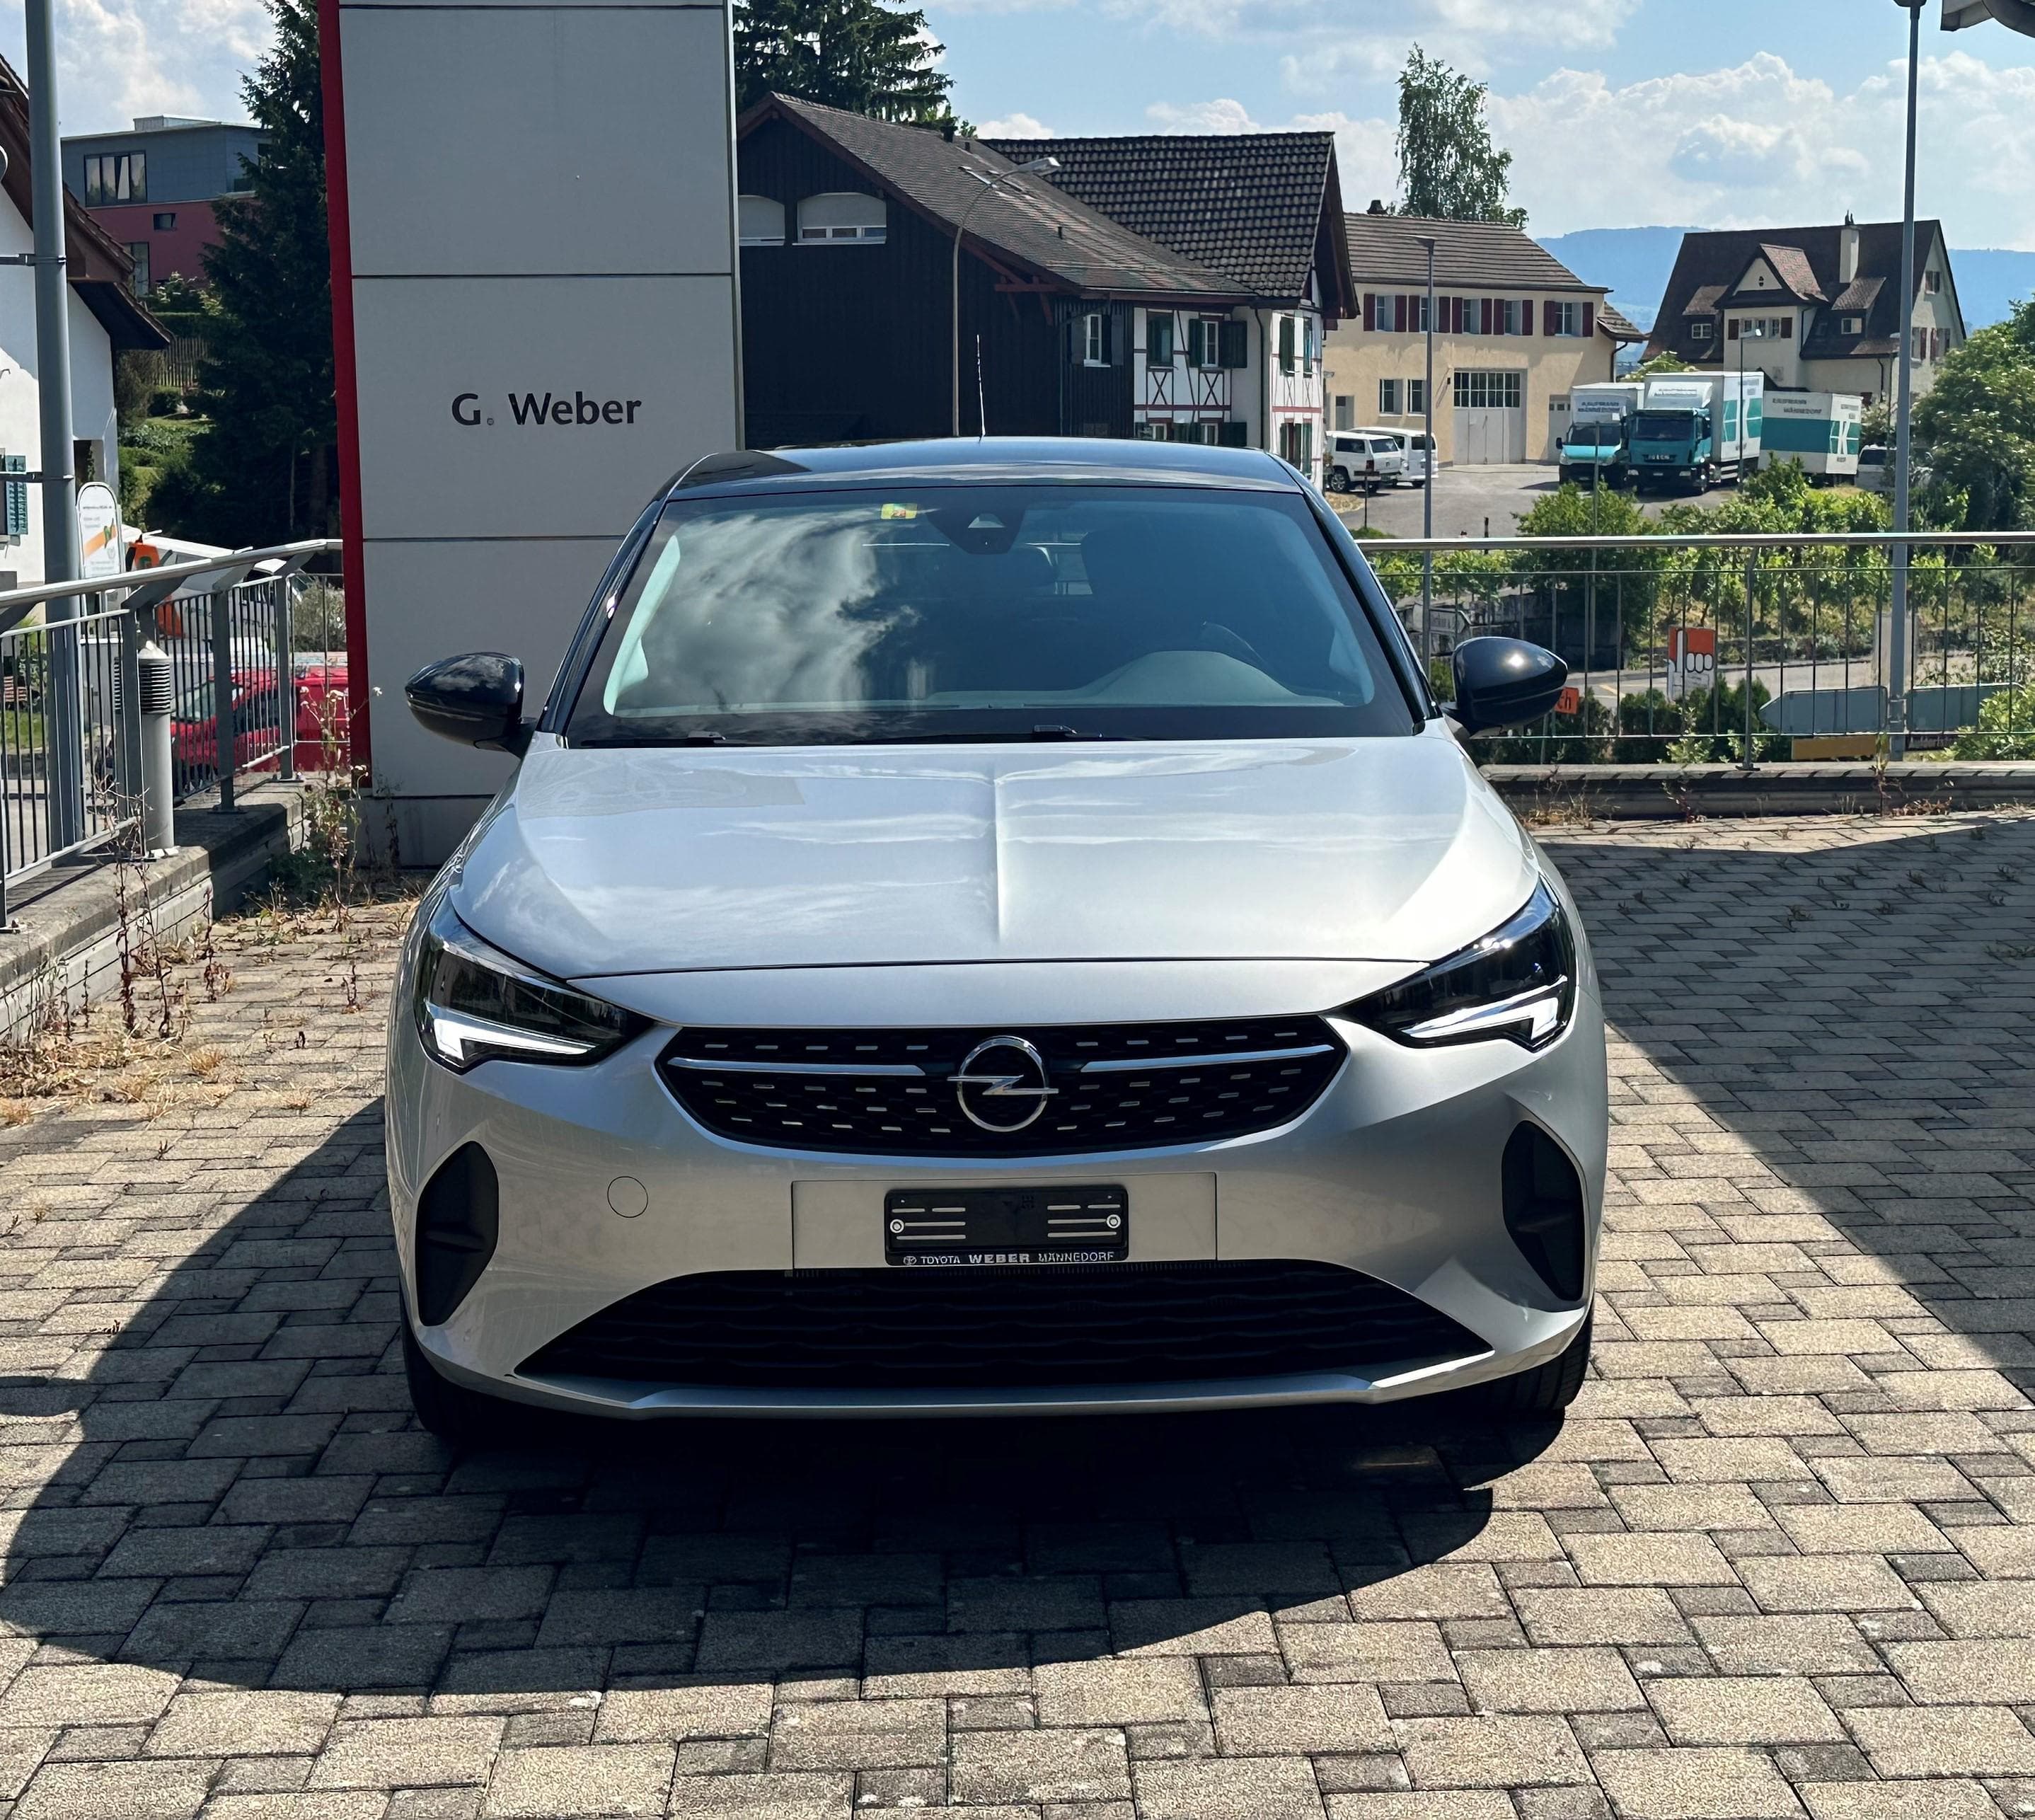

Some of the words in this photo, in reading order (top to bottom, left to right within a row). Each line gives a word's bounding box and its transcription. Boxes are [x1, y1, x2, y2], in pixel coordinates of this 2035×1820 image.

[451, 393, 495, 425] G.
[507, 391, 642, 425] Weber
[921, 1255, 960, 1265] TOYOTA
[968, 1253, 1030, 1264] WEBER
